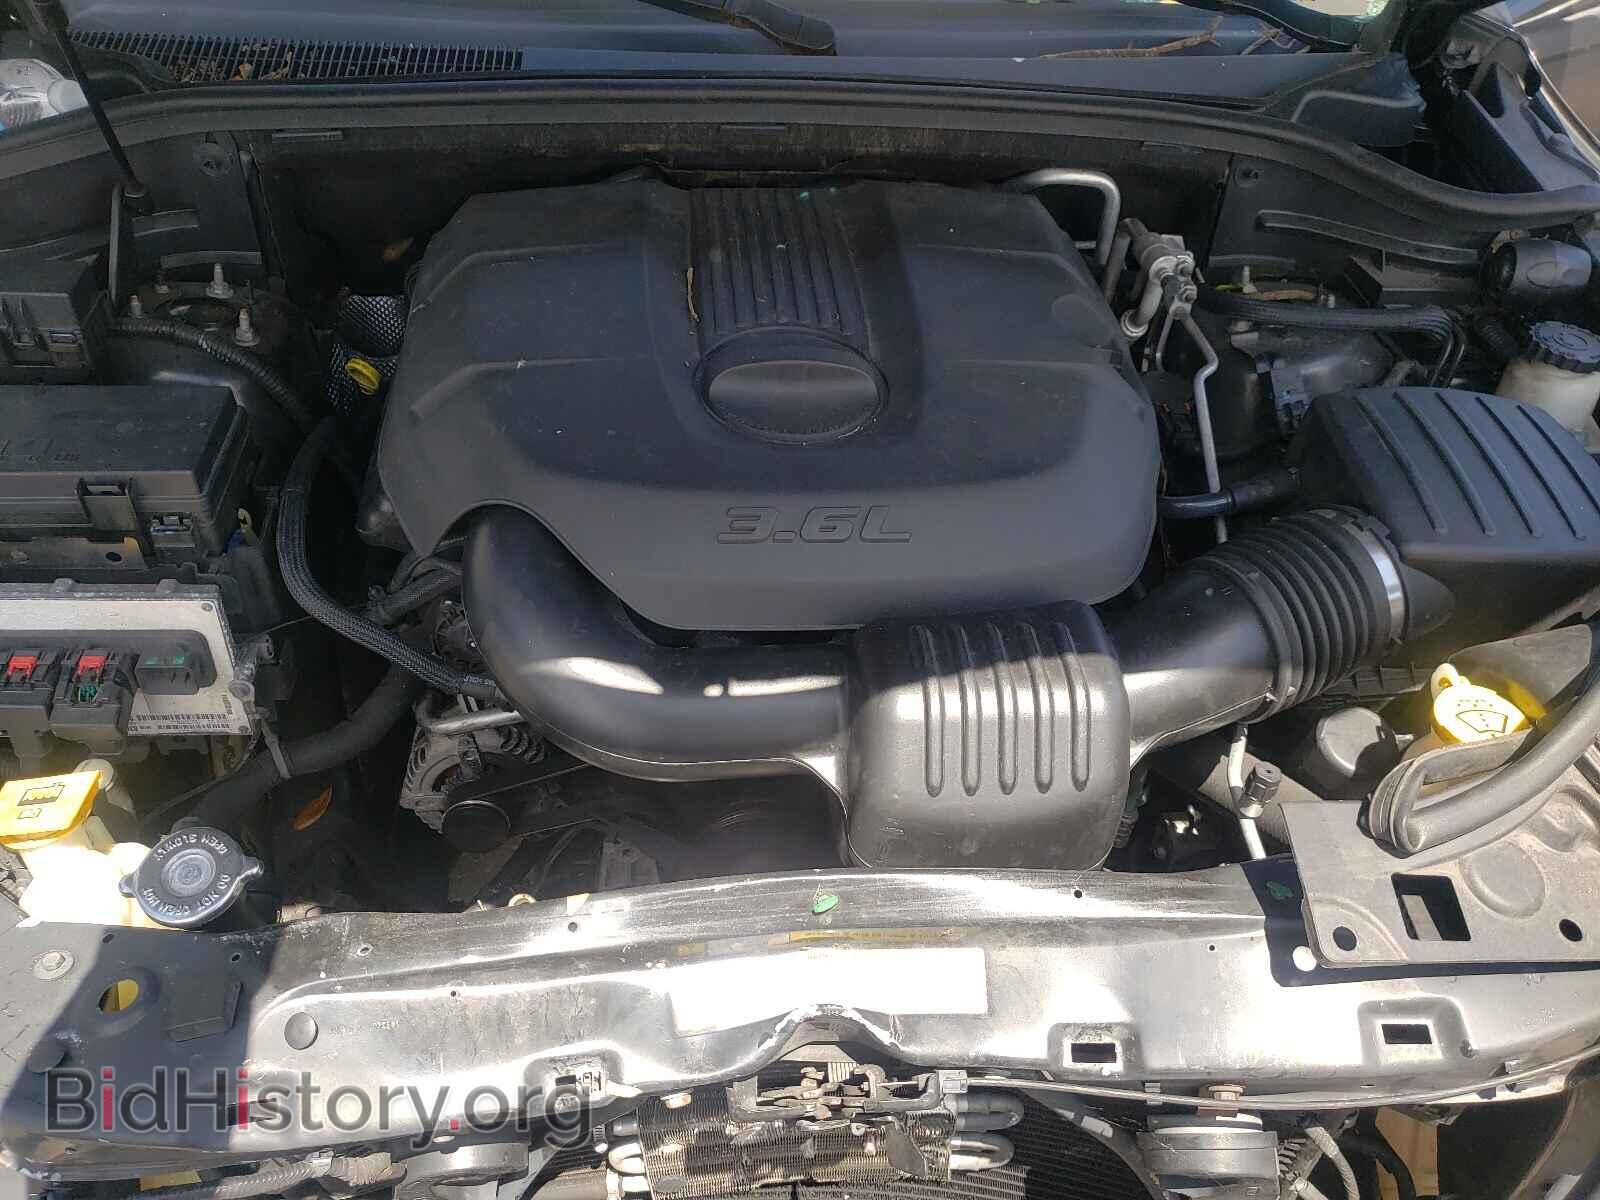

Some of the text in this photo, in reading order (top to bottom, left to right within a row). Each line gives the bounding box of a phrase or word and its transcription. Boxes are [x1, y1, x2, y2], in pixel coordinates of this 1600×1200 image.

[716, 504, 913, 544] 3.6L
[154, 833, 229, 860] OPEN SLOWLY
[143, 874, 231, 916] DO NOT OPEN HOT
